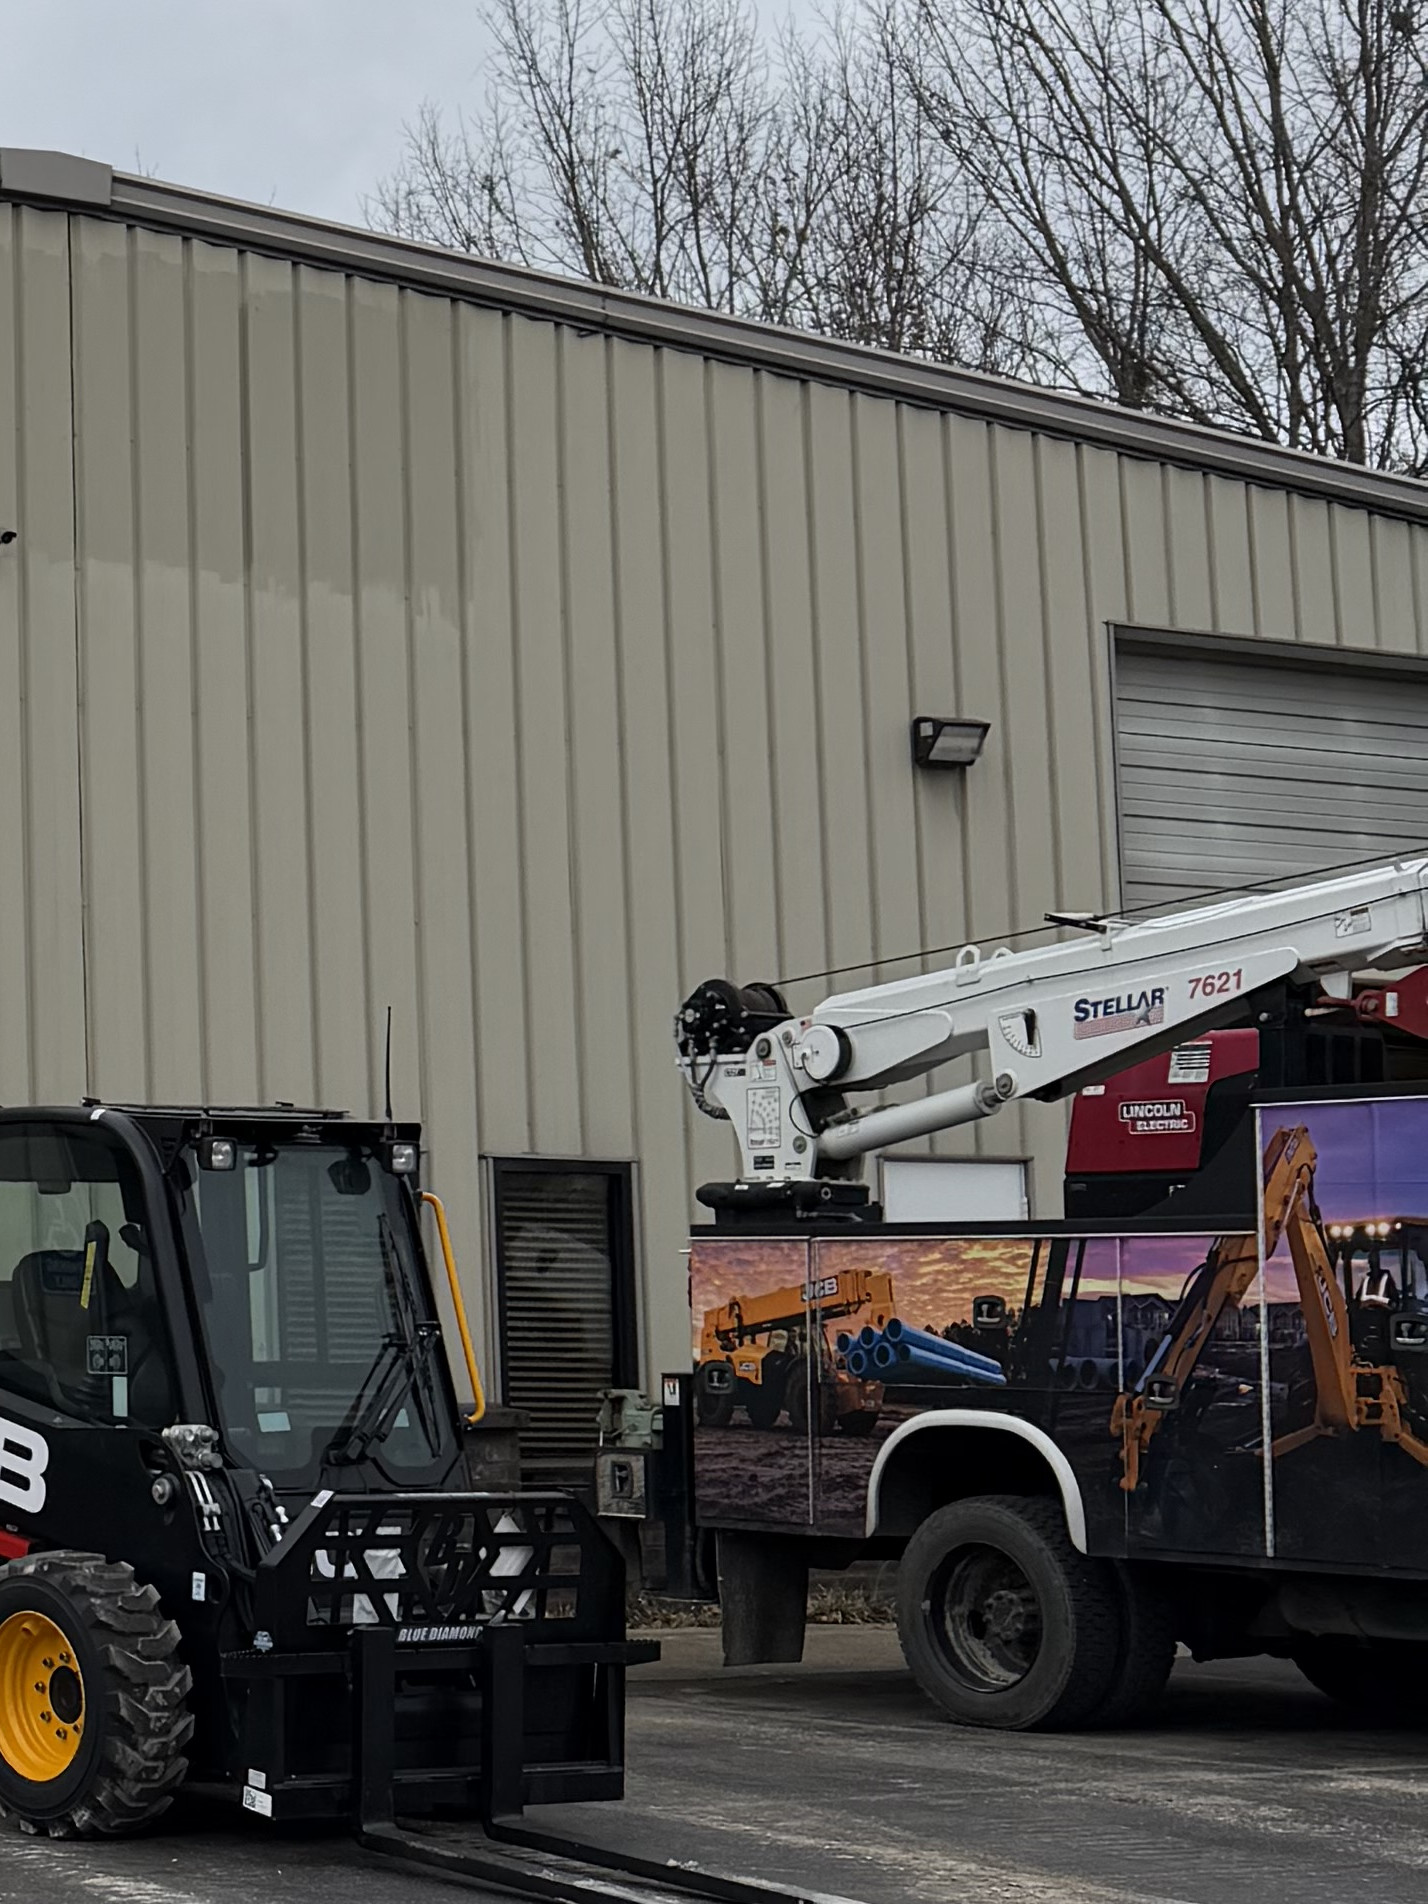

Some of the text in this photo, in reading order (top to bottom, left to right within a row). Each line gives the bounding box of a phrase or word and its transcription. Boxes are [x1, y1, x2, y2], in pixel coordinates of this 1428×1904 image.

[1074, 968, 1243, 1022] STELLAR 7621
[1122, 1103, 1181, 1118] LINCOLN
[397, 1627, 429, 1642] BLUE
